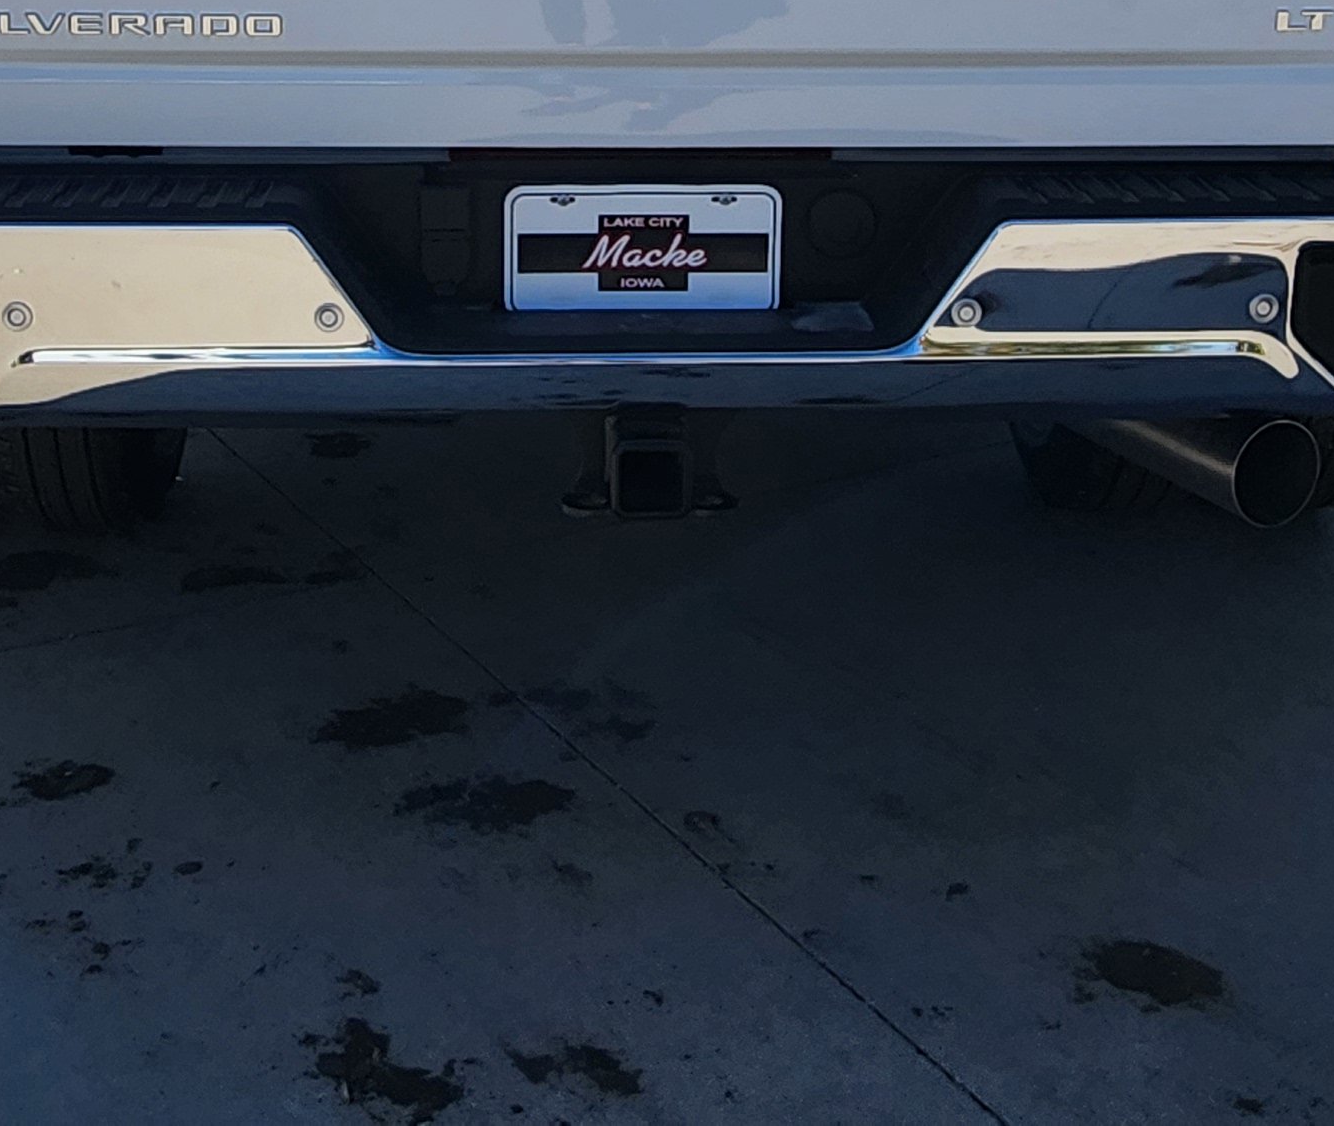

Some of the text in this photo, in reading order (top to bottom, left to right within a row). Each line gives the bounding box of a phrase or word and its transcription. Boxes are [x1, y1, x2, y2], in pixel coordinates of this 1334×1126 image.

[1275, 9, 1334, 31] LT
[603, 217, 683, 227] LAKE CITY
[582, 233, 707, 268] Macke
[620, 277, 665, 288] IOWA
